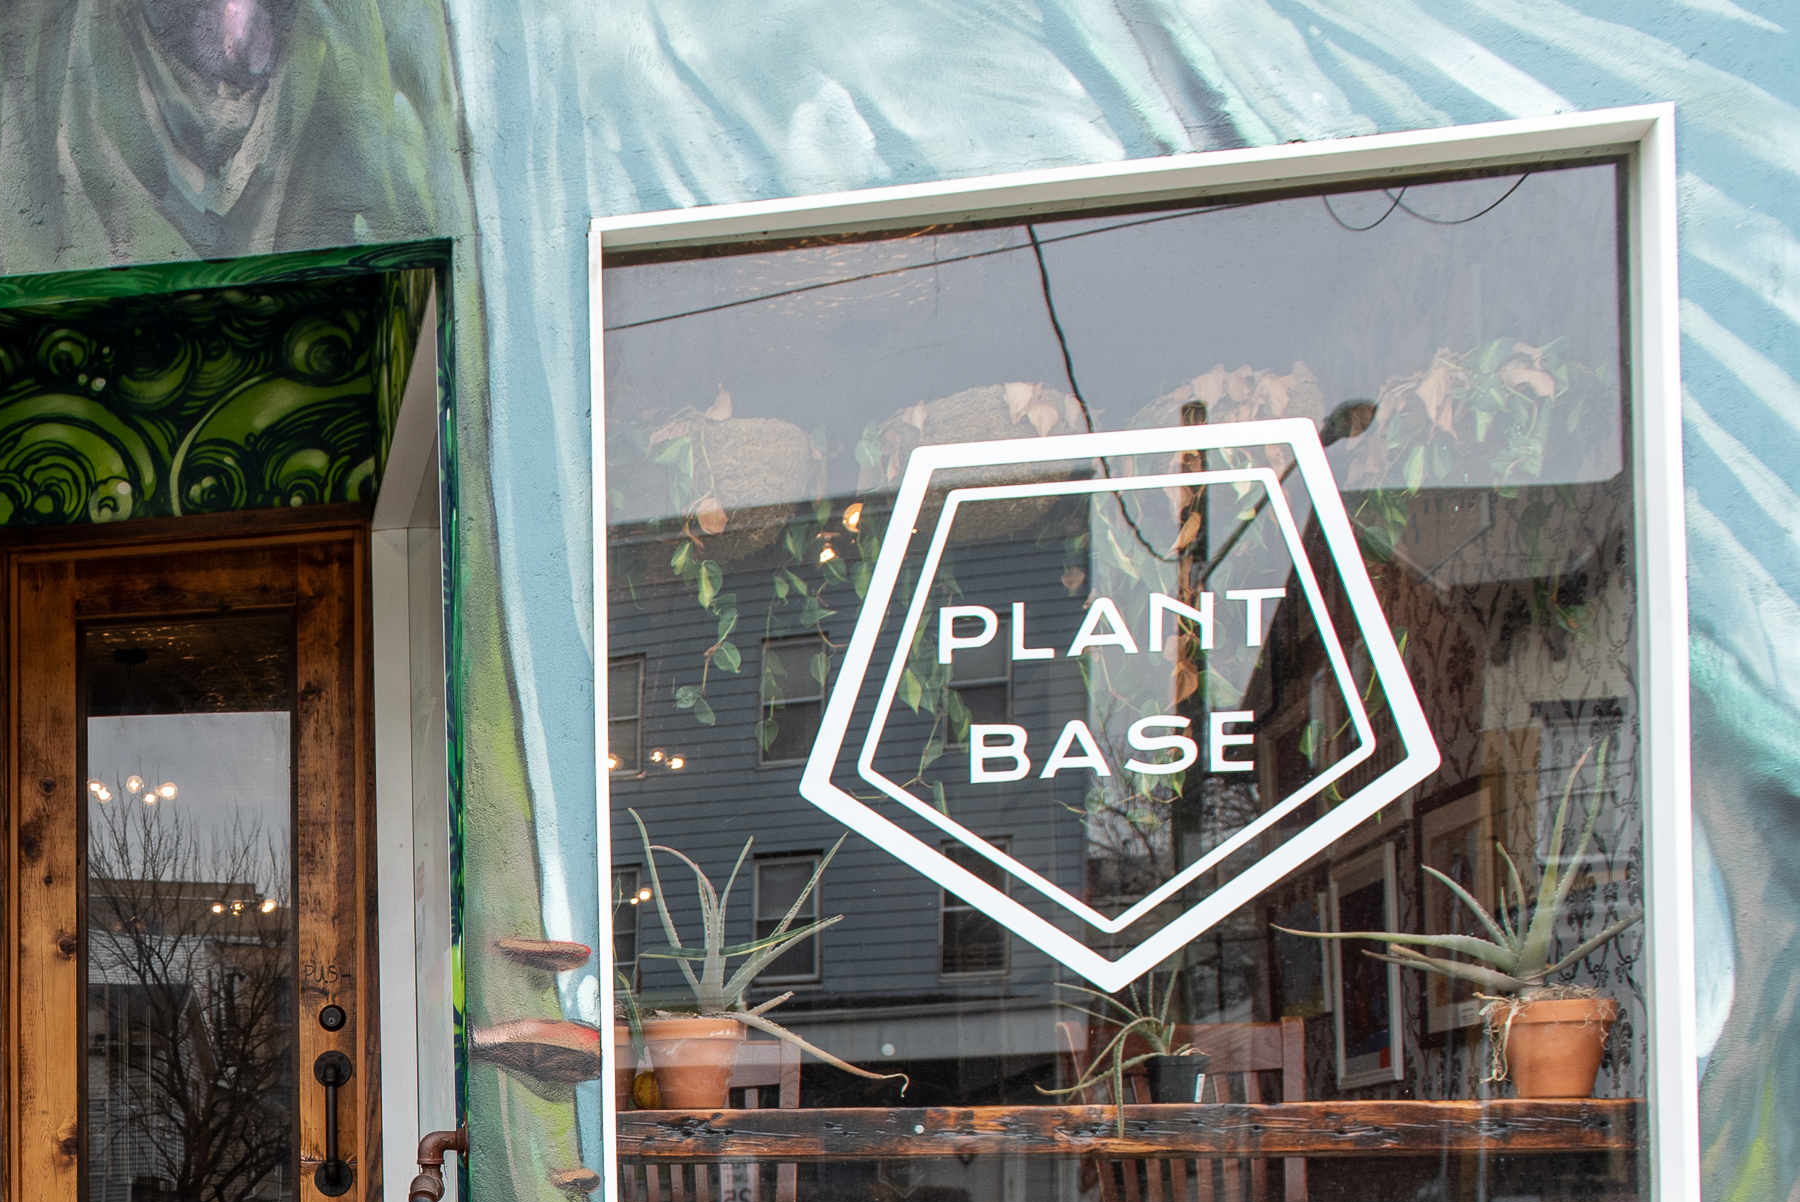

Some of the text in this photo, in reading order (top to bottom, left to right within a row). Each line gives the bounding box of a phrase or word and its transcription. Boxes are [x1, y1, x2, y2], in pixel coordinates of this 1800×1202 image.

[938, 587, 1287, 665] PLANT
[969, 710, 1255, 784] BASE
[304, 965, 352, 985] PUSH
